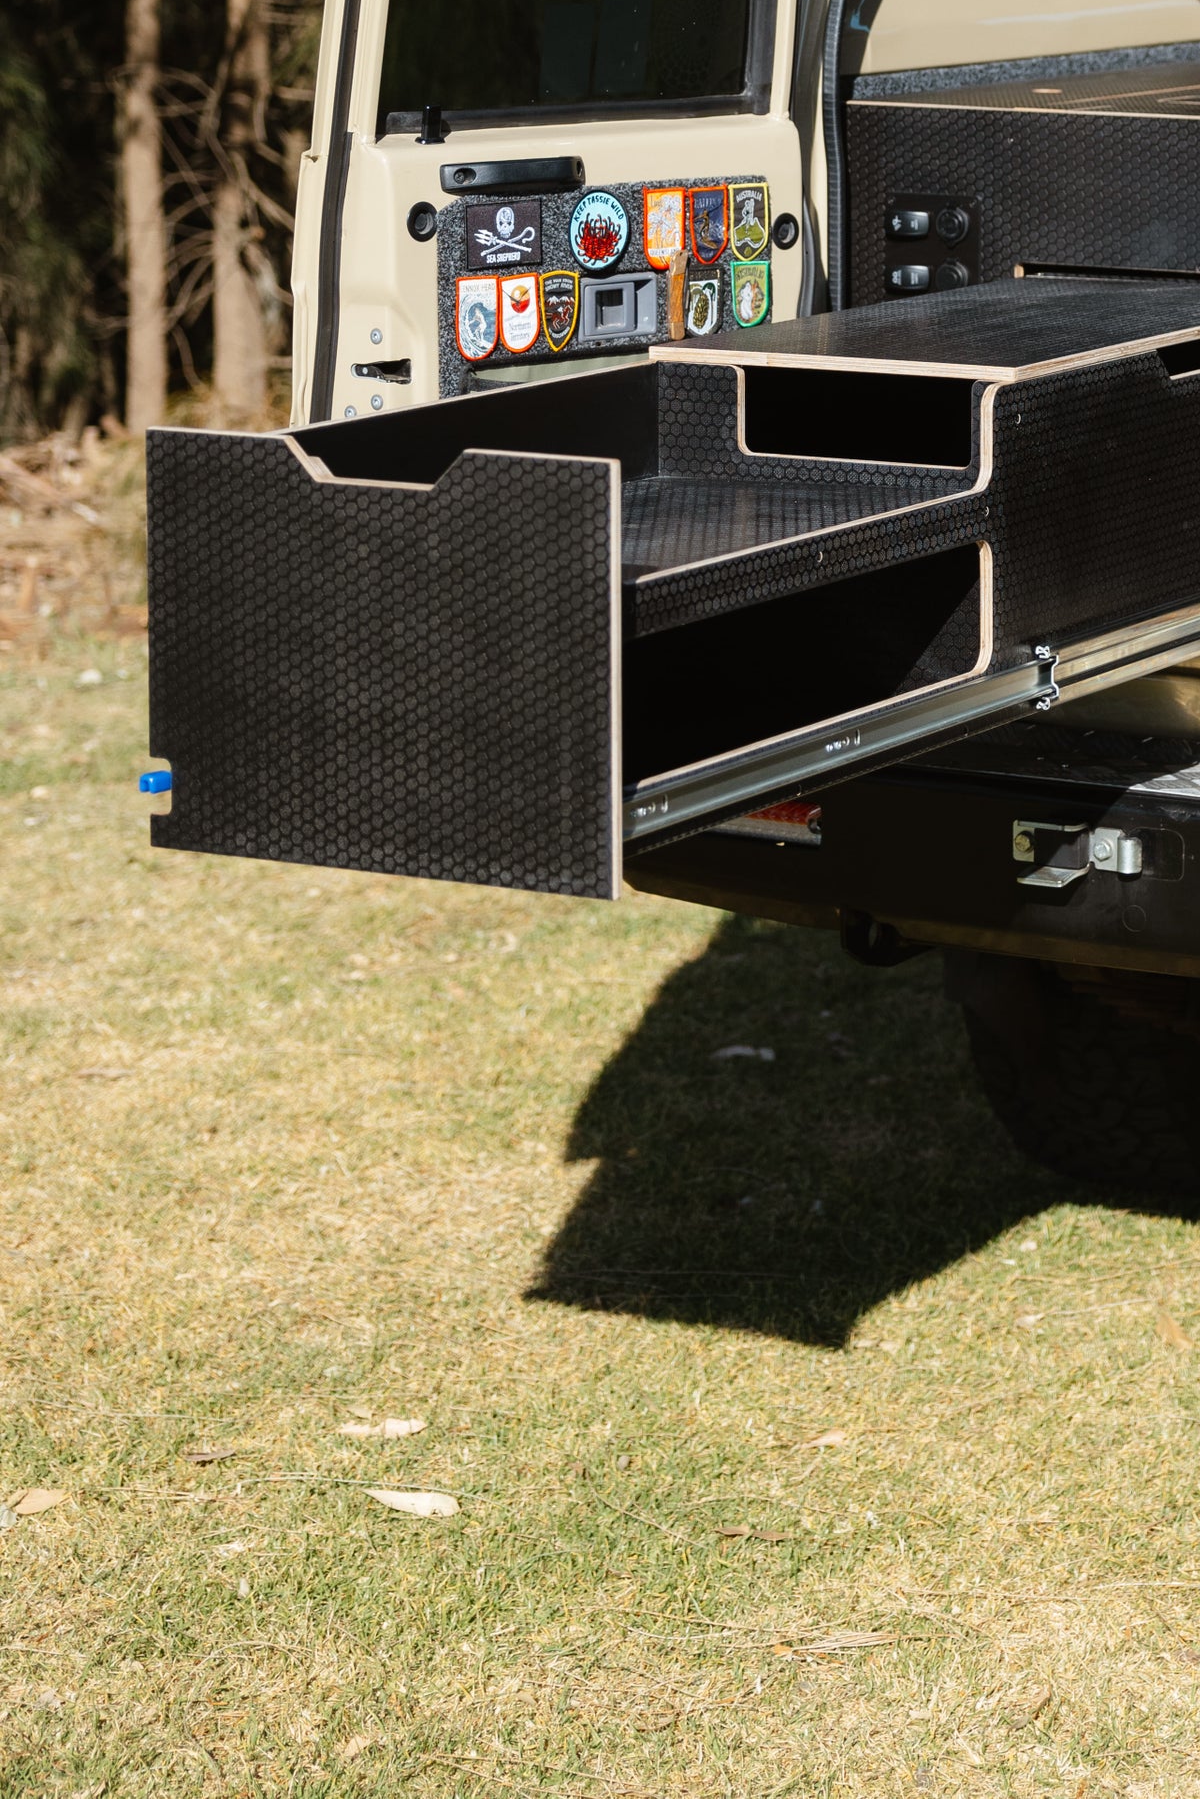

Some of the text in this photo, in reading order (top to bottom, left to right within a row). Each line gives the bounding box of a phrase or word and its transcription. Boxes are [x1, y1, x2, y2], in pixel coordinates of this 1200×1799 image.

[736, 189, 762, 203] AUSTRALIA
[573, 195, 624, 222] KEEP TASSIE WILD
[486, 251, 520, 263] SEA SHEPHERD
[461, 282, 496, 293] ENNOX HEAD
